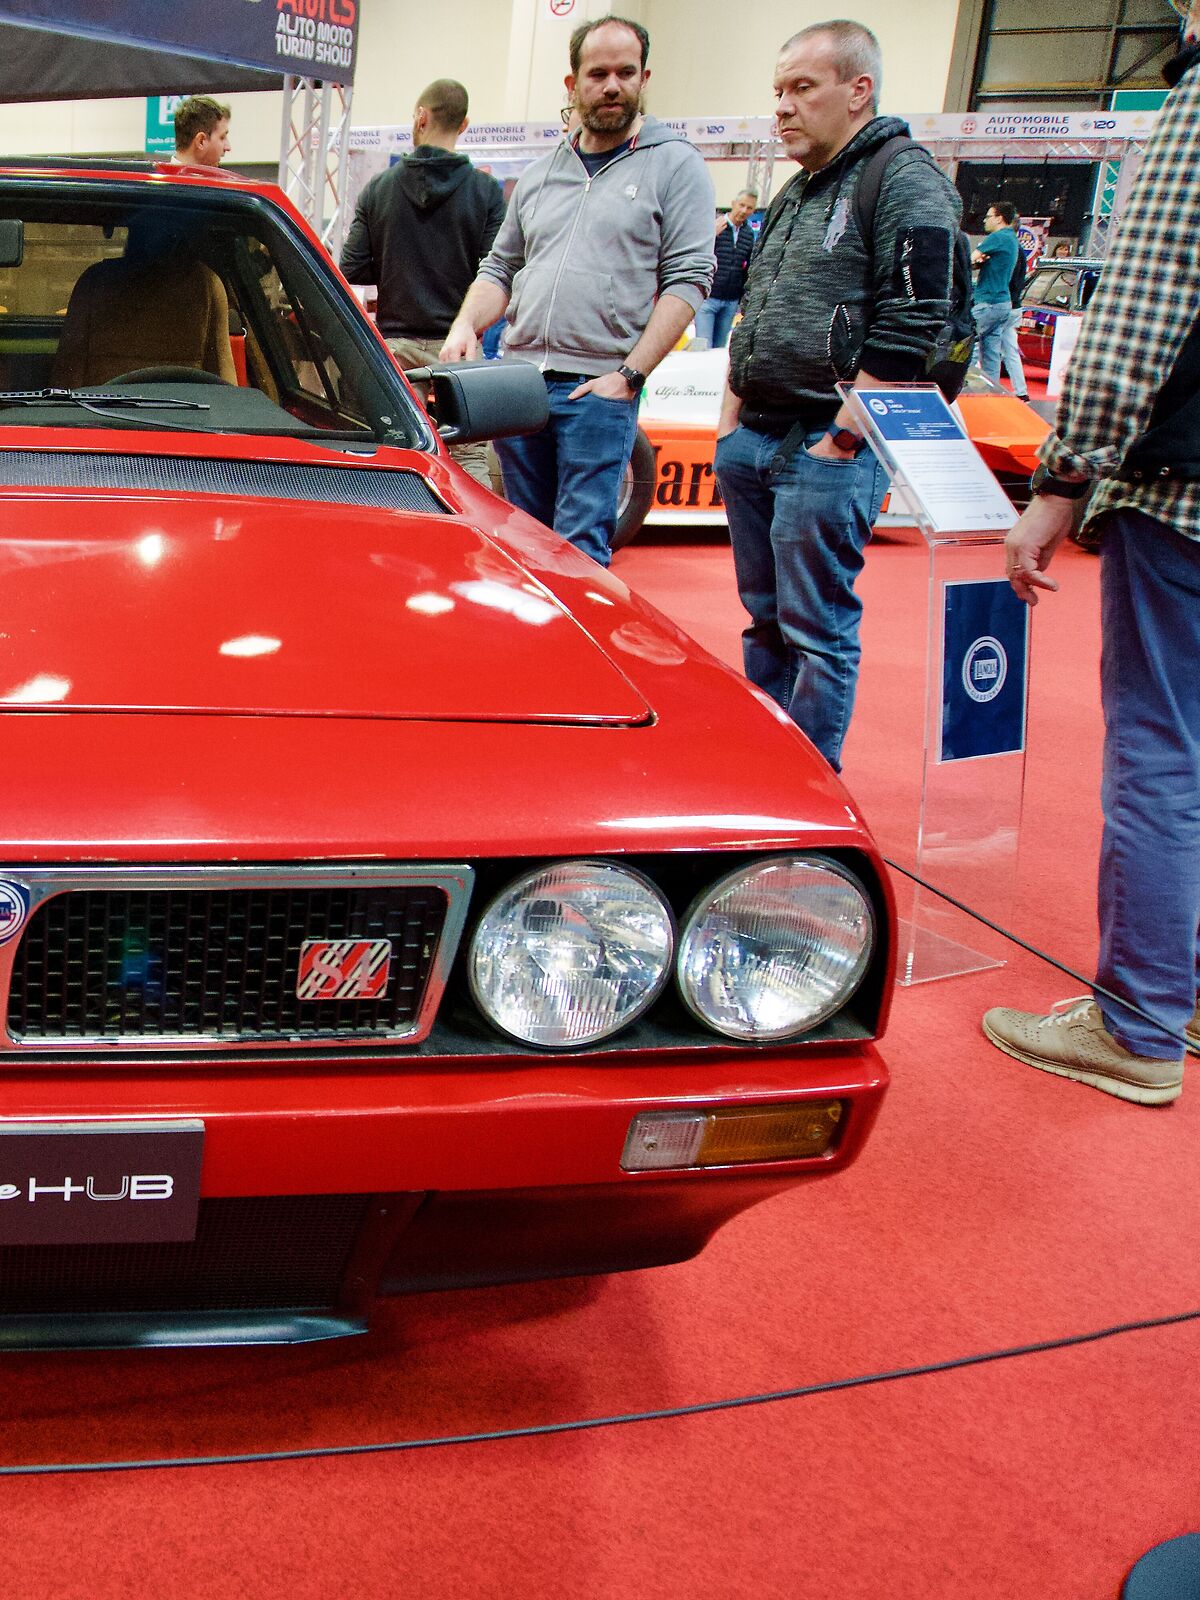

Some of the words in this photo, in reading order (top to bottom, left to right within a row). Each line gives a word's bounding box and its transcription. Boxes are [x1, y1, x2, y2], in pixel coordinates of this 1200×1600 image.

[276, 12, 316, 39] AUTO
[317, 22, 353, 47] MOTO
[275, 33, 315, 60] TURIN
[315, 42, 352, 67] SHOW
[988, 116, 1070, 124] AUTOMOBILE
[1093, 120, 1116, 129] 120
[467, 126, 526, 134] AUTOMOBILE
[543, 129, 559, 138] 120
[706, 125, 725, 134] 120
[985, 126, 1016, 134] CLUB
[1022, 126, 1070, 134] TORINO
[464, 135, 487, 143] CLUB
[655, 386, 681, 400] Alfa
[28, 1174, 174, 1202] HUB
